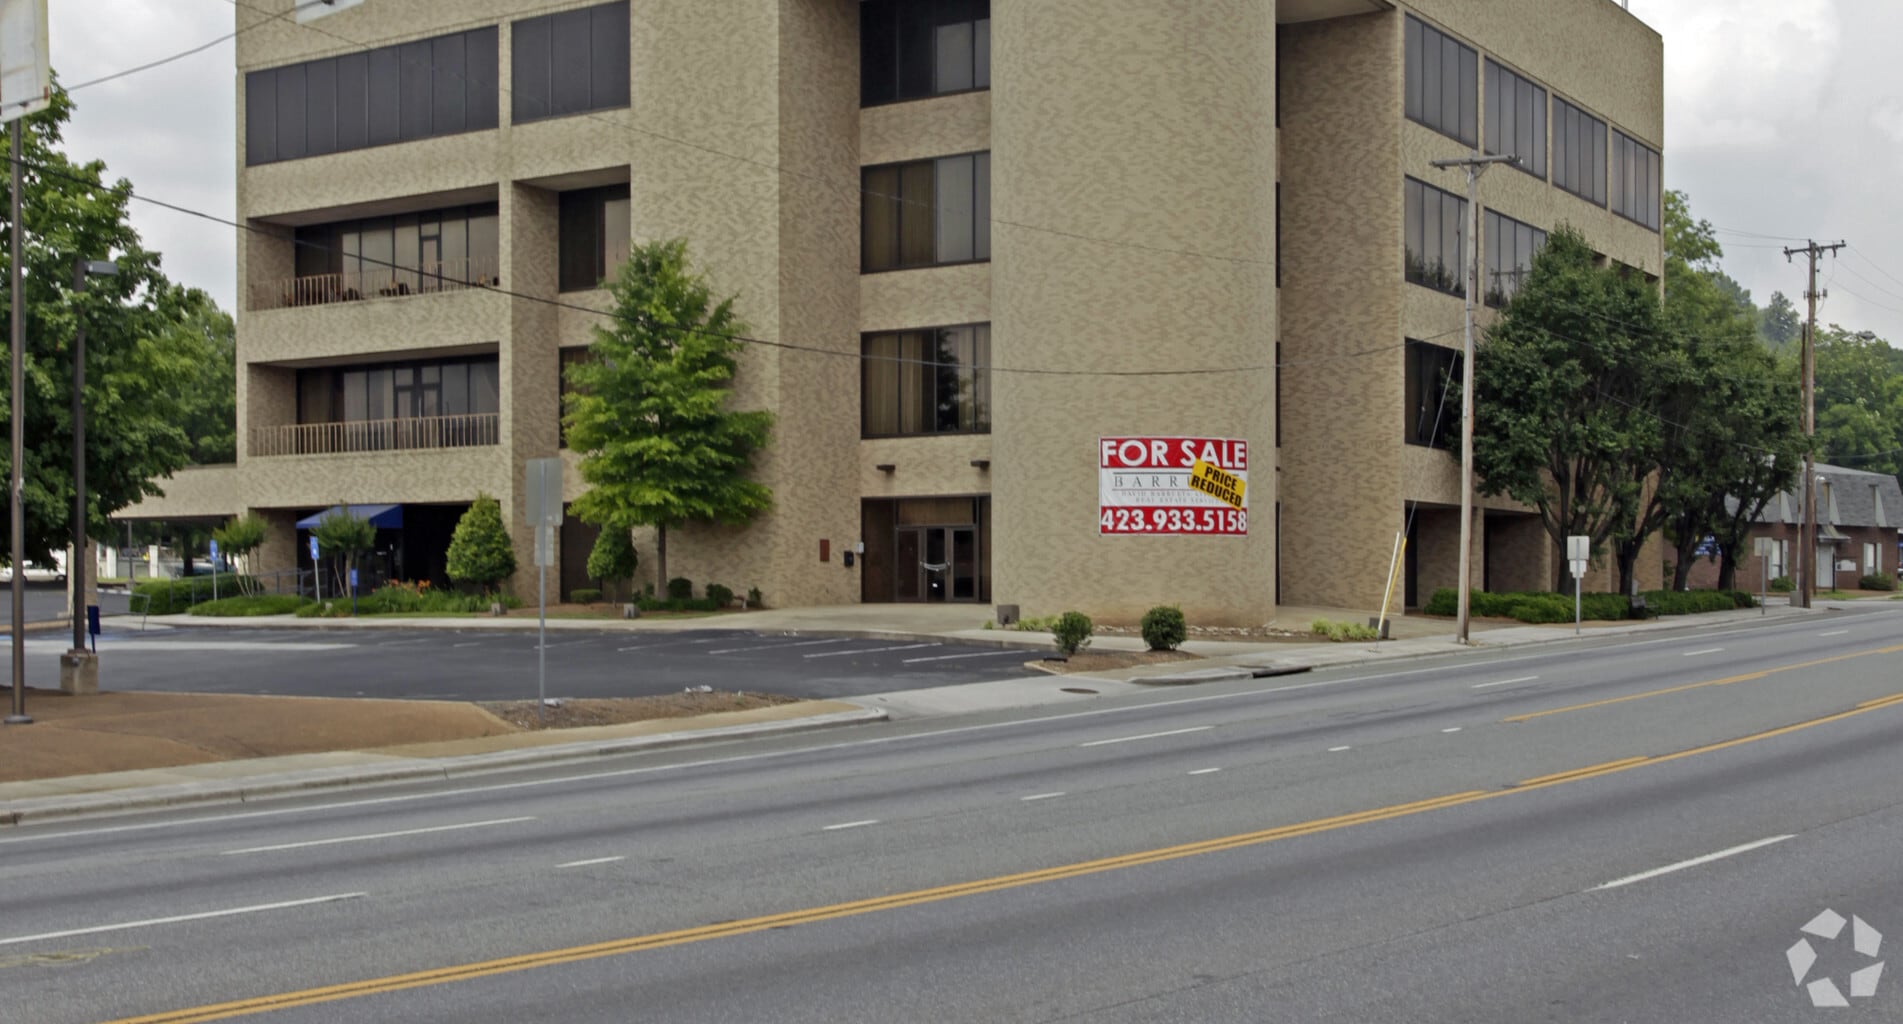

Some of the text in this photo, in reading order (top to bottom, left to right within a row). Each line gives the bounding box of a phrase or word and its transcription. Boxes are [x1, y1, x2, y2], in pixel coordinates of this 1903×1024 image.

[1101, 440, 1246, 469] FOR SALE
[1191, 475, 1242, 508] REDUCED
[1204, 466, 1237, 491] PRICE
[1101, 509, 1247, 532] 423.933.5158
